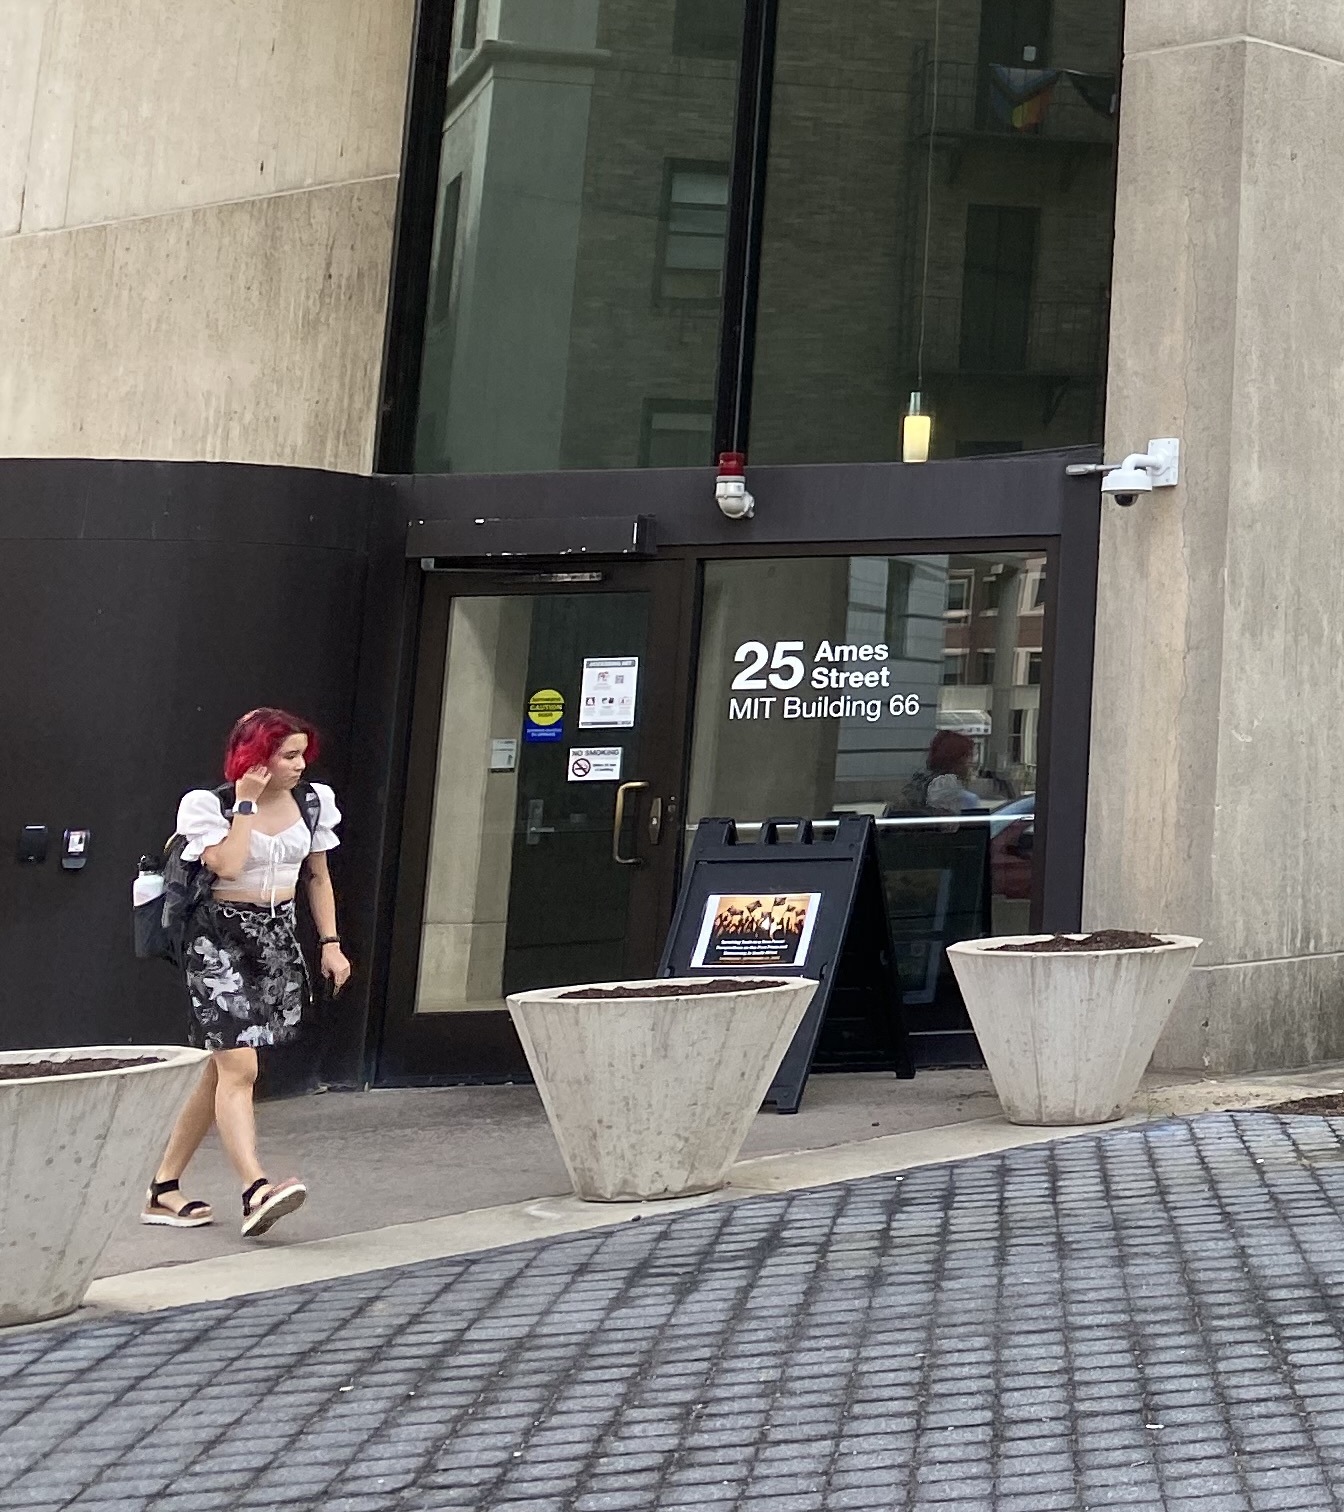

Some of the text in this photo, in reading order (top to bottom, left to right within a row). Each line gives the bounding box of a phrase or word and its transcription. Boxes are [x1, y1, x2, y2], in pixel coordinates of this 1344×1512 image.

[813, 640, 889, 663] Ames
[731, 640, 805, 690] 25
[811, 666, 891, 689] Street
[729, 693, 920, 722] MIT Building 66
